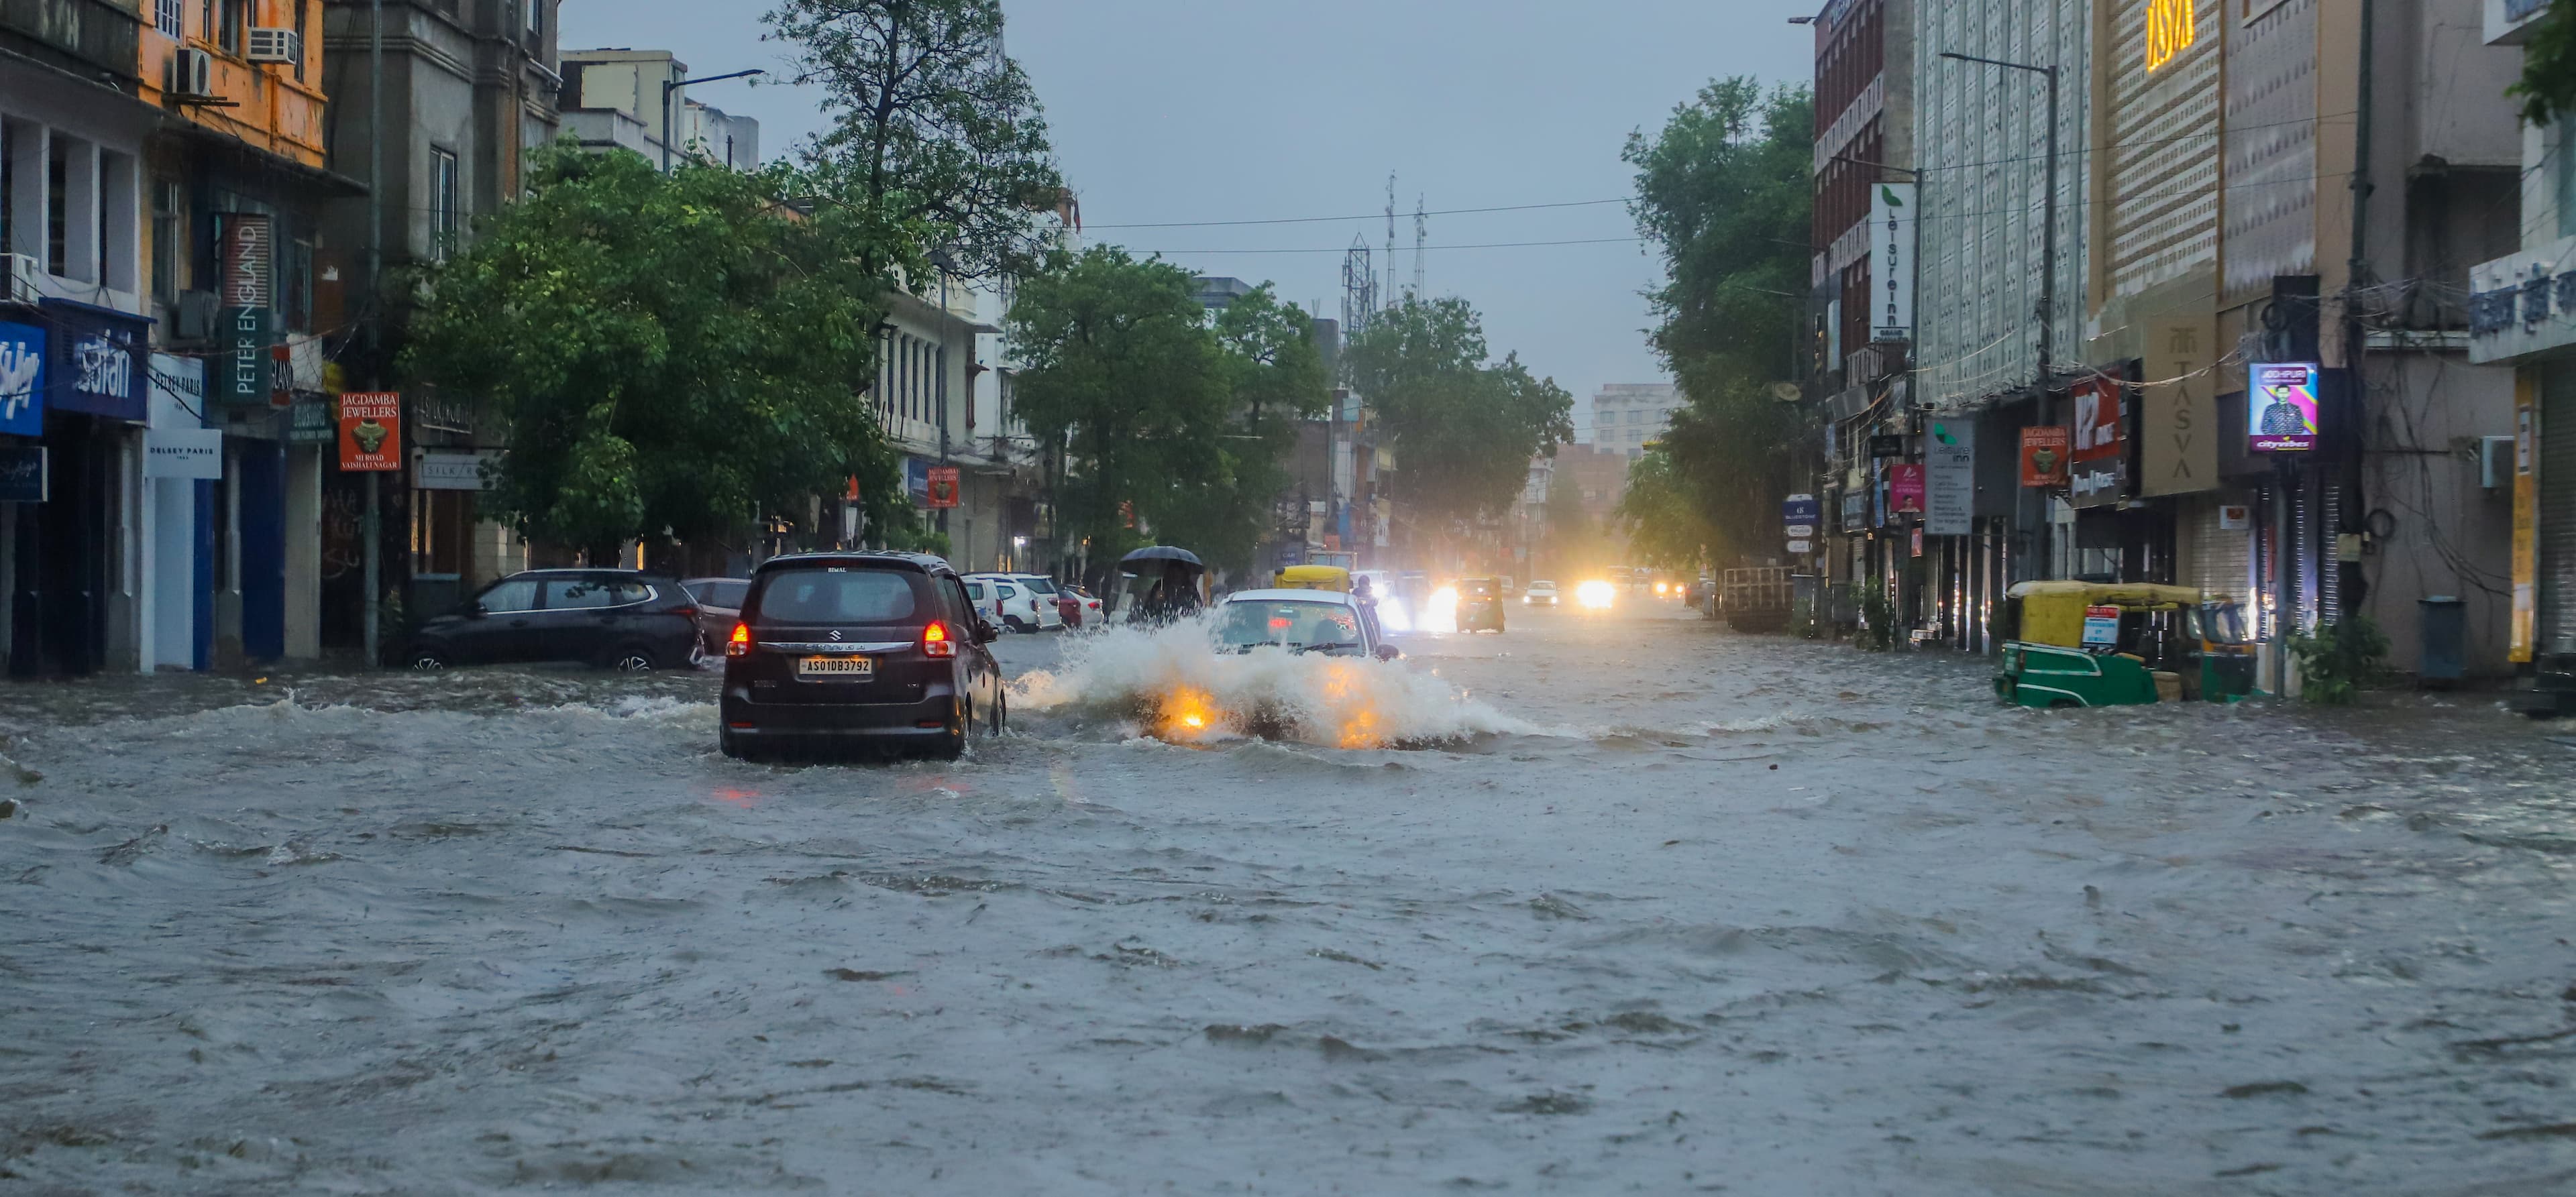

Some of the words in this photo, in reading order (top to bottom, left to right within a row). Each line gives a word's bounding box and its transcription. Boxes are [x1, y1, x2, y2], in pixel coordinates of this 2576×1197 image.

[237, 225, 256, 331] ENGLAND
[237, 336, 255, 394] PETER
[156, 373, 180, 392] DELSEY
[181, 376, 200, 396] PARIS
[342, 394, 396, 406] JAGDAMBA
[342, 406, 396, 419] JEWELLERS
[1934, 446, 1970, 455] Leisure
[2257, 440, 2309, 449] cityvibes
[150, 447, 185, 455] DELSEY
[808, 661, 869, 671] AS01DB3792
